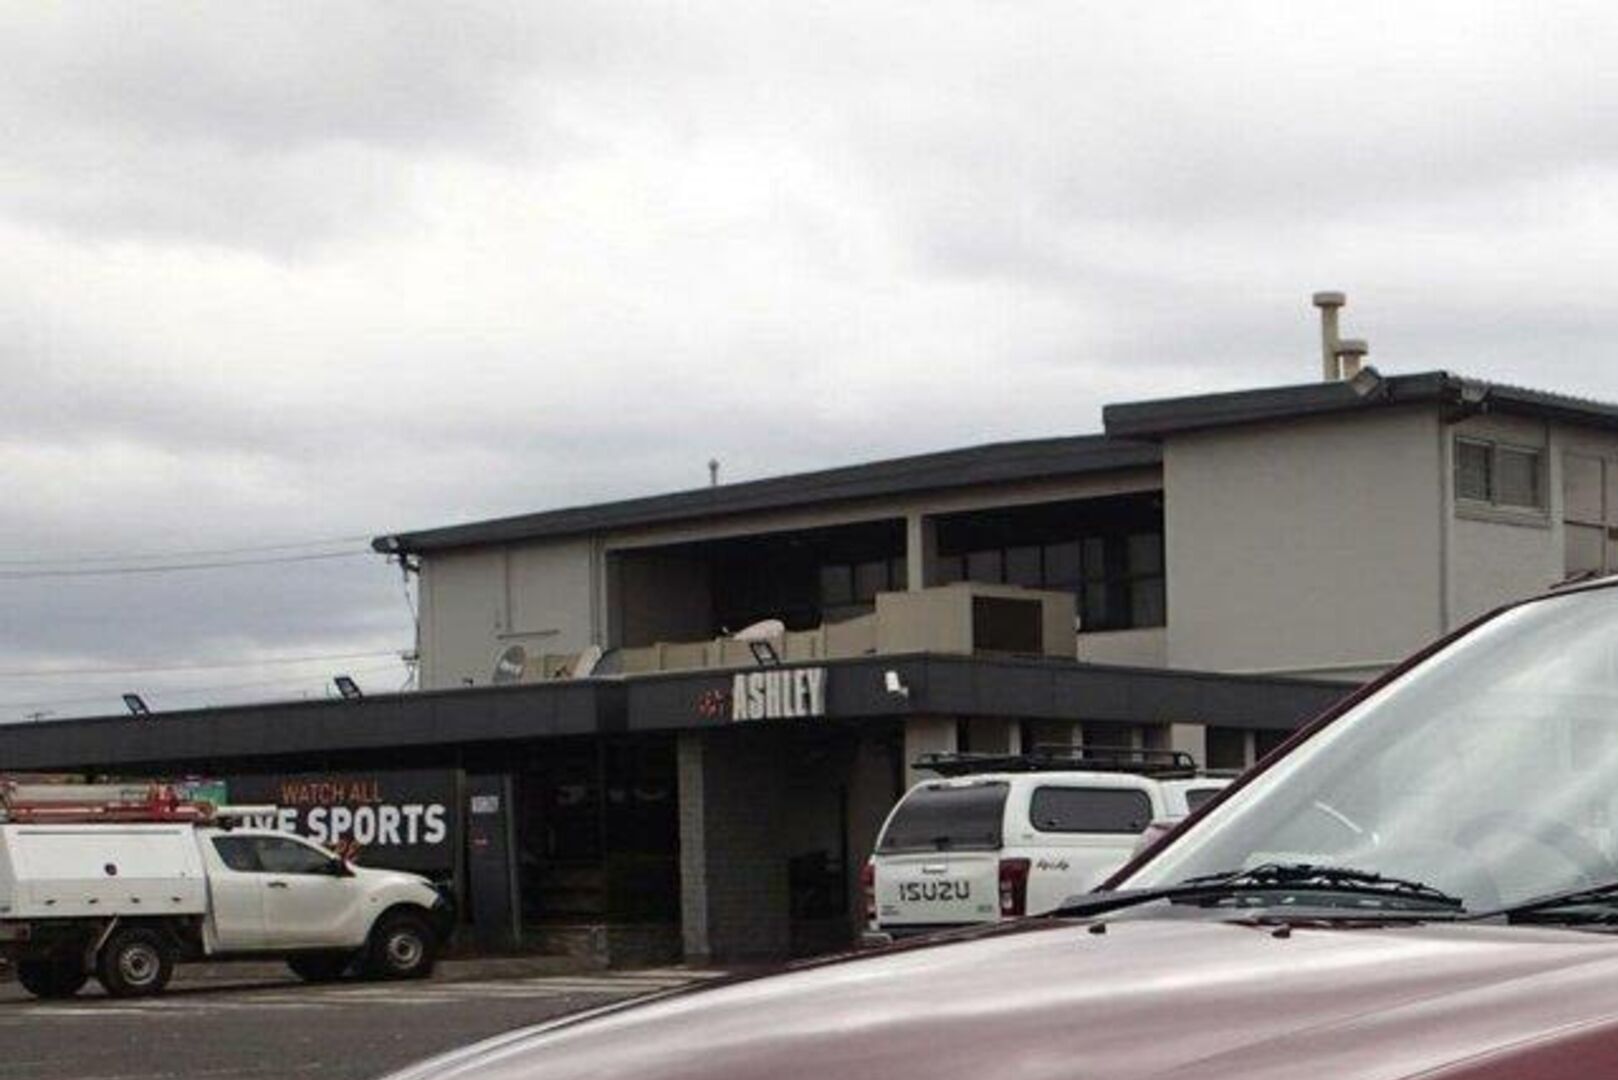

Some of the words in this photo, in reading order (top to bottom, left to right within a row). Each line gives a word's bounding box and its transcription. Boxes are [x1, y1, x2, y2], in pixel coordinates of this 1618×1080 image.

[733, 667, 827, 721] ASHLEY
[282, 782, 344, 804] WATCH
[350, 781, 382, 802] ALL
[307, 803, 446, 845] SPORTS
[900, 880, 970, 902] ISUZU
